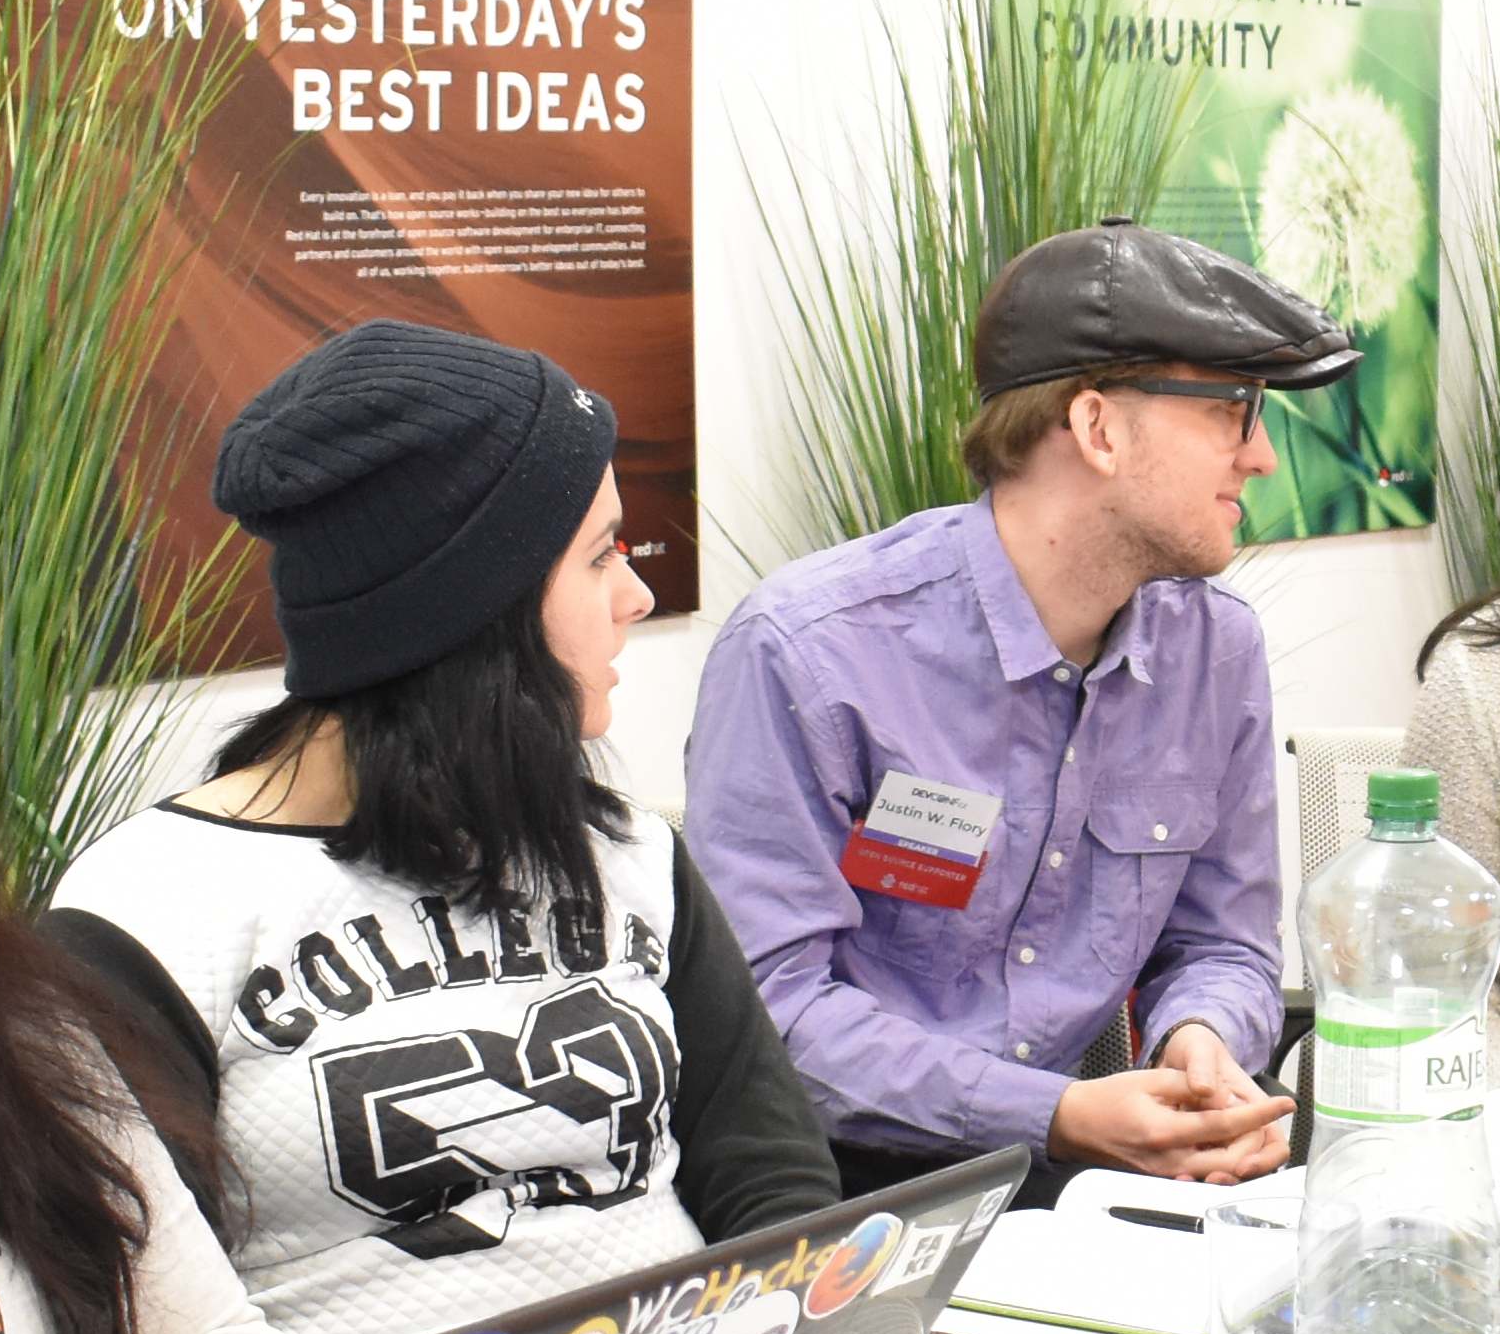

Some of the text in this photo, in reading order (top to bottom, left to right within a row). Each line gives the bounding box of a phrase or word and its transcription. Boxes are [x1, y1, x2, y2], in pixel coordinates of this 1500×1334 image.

[293, 67, 646, 134] BEST IDEAS
[877, 798, 988, 838] Justin W. Flory
